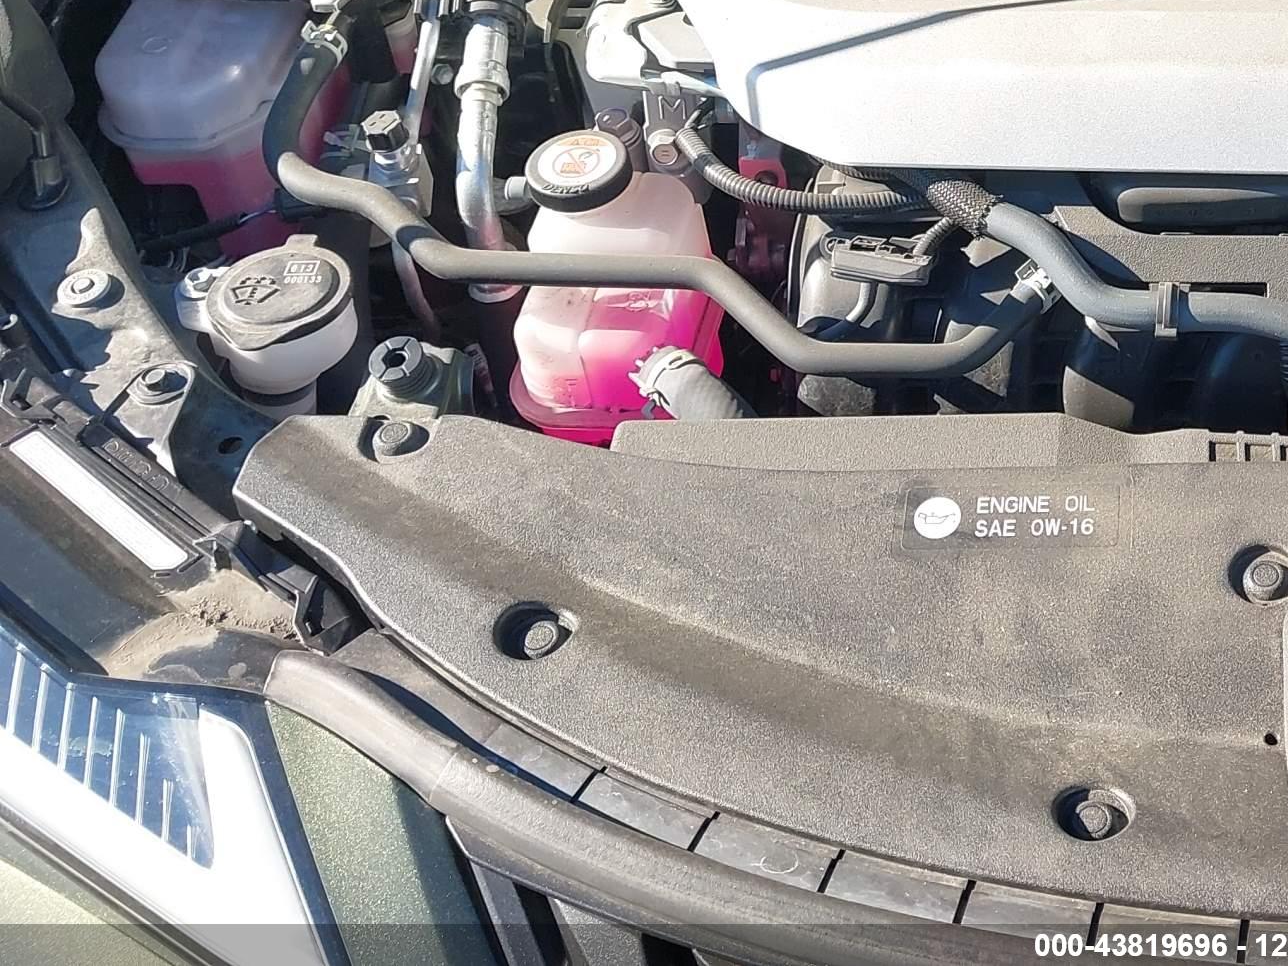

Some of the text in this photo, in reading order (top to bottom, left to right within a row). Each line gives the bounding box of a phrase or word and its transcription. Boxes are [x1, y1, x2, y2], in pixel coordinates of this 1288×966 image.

[541, 184, 591, 195] DENSO
[976, 495, 1095, 514] ENGINE OIL
[975, 518, 1095, 538] SAE 0W-16
